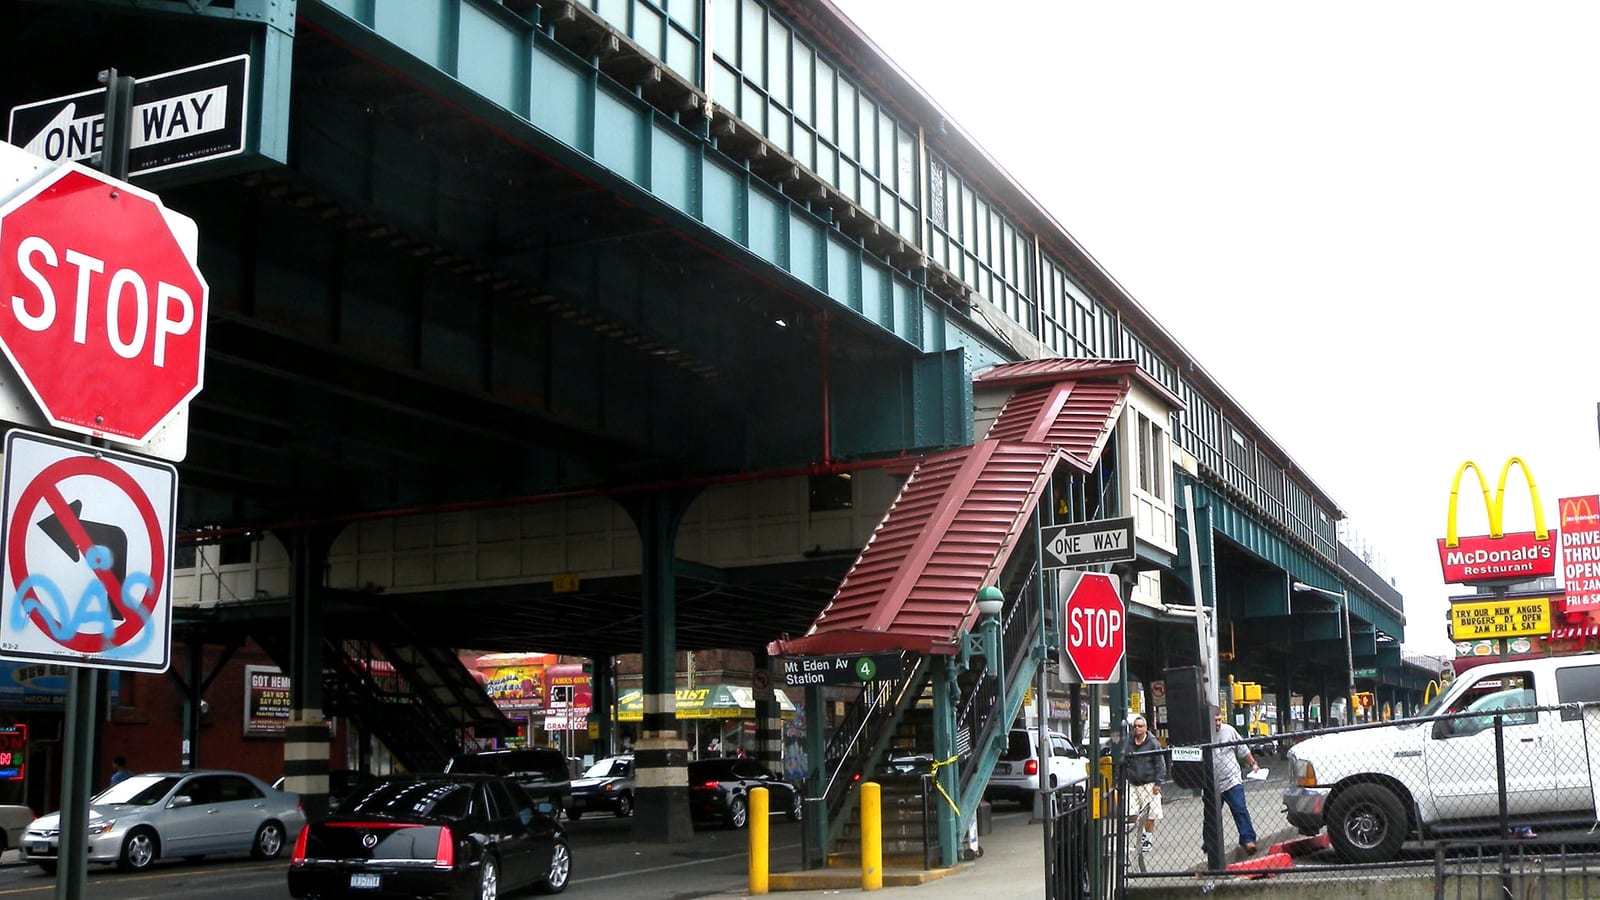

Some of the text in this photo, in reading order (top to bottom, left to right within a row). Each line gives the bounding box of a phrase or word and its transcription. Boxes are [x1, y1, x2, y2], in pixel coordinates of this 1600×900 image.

[45, 93, 214, 161] ONE WAY
[11, 236, 194, 368] STOP
[1055, 531, 1122, 555] ONE WAY
[1563, 530, 1600, 546] DRIVE
[1447, 545, 1551, 565] McDonald's
[1564, 546, 1600, 562] THRU
[1464, 562, 1533, 575] Restaurant
[1566, 581, 1581, 591] TIL
[1566, 595, 1581, 606] FRI
[1582, 594, 1589, 604] &
[1456, 605, 1542, 618] TRY OUR NEW ANGUS
[1461, 616, 1495, 626] BURGERS
[1522, 613, 1541, 621] OPEN
[1070, 607, 1121, 648] STOP
[1474, 622, 1536, 633] 2AM FRI & SAT
[784, 658, 871, 676] Mt Eden Av 4
[252, 675, 269, 687] GOT
[786, 672, 825, 685] Station
